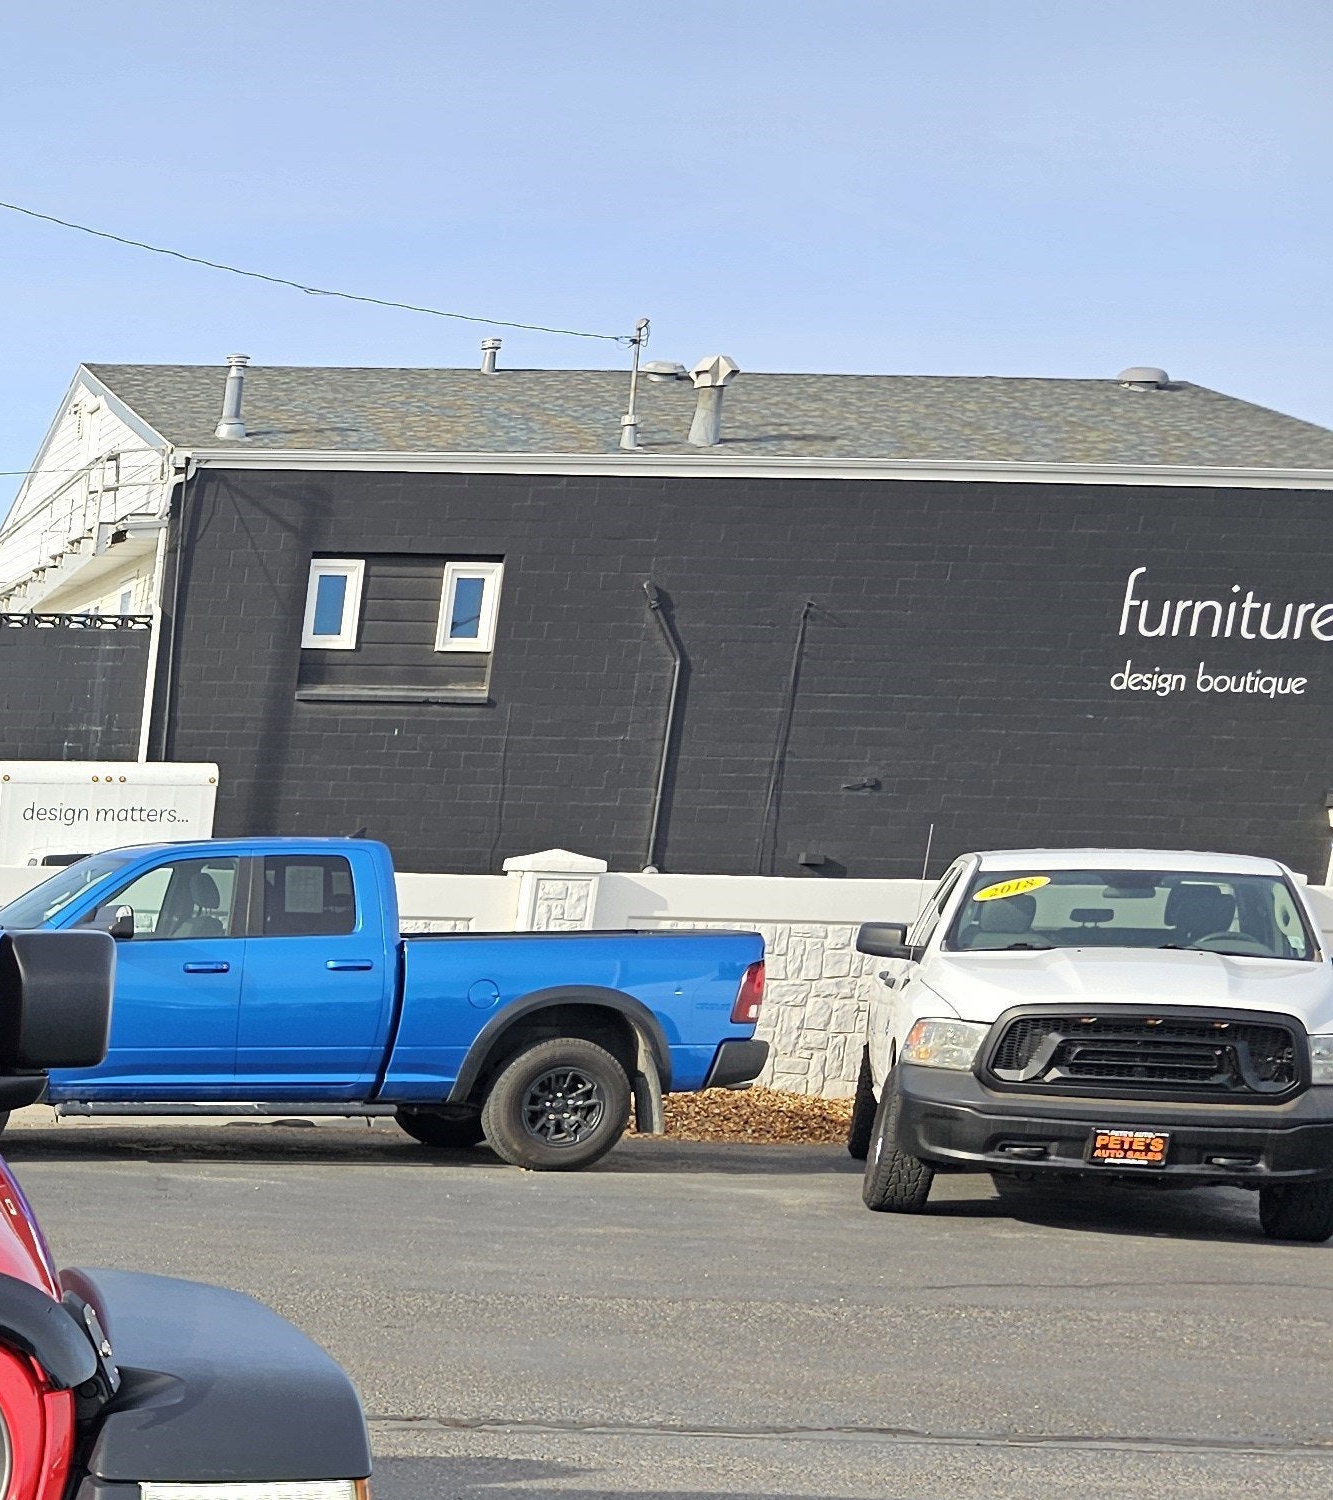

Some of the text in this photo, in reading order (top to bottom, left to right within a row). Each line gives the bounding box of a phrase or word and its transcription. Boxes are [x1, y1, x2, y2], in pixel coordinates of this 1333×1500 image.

[1118, 566, 1333, 641] furniture
[1110, 659, 1308, 699] design boutique
[22, 801, 190, 826] design matters...
[989, 878, 1035, 897] 2018
[1093, 1149, 1125, 1159] AUTO
[1095, 1135, 1164, 1152] PETE'S
